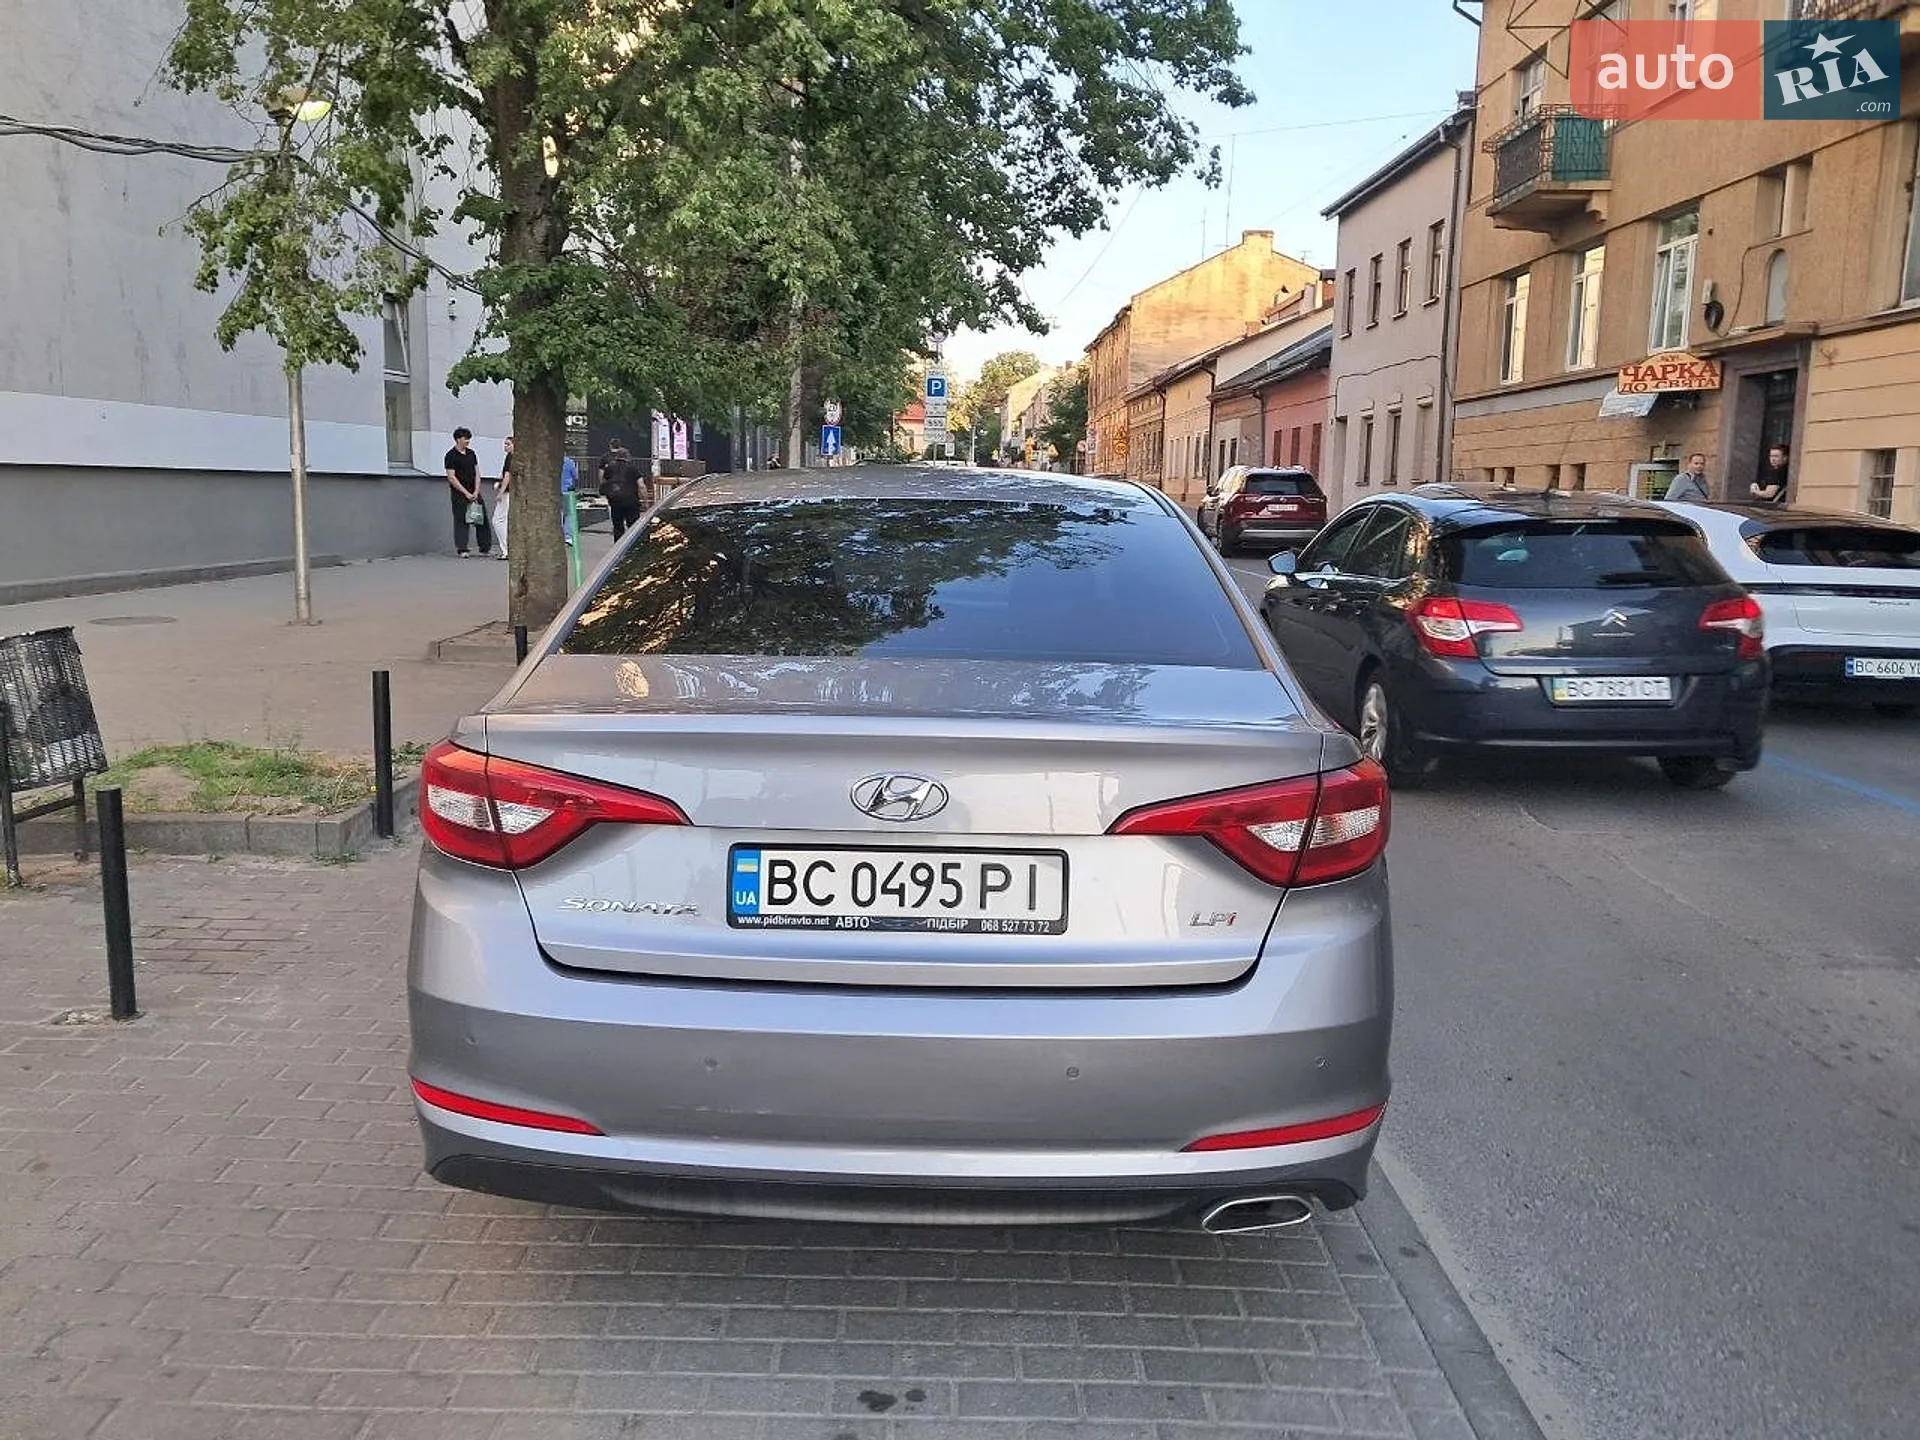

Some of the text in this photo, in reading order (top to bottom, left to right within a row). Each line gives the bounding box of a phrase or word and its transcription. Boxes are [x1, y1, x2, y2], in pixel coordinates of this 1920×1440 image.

[1620, 360, 1719, 382] ЧАРКА
[1621, 377, 1717, 393] ДО СВЯТА
[1855, 660, 1874, 673] BC
[1876, 661, 1905, 674] 6606
[766, 859, 1038, 911] BC 0495 PI
[735, 891, 757, 906] UA
[559, 898, 699, 916] SONATA
[737, 916, 830, 927] www.pidbiravto.net
[835, 916, 969, 930] АВТО ПІДБІР
[981, 919, 1050, 933] 068 527 73 72
